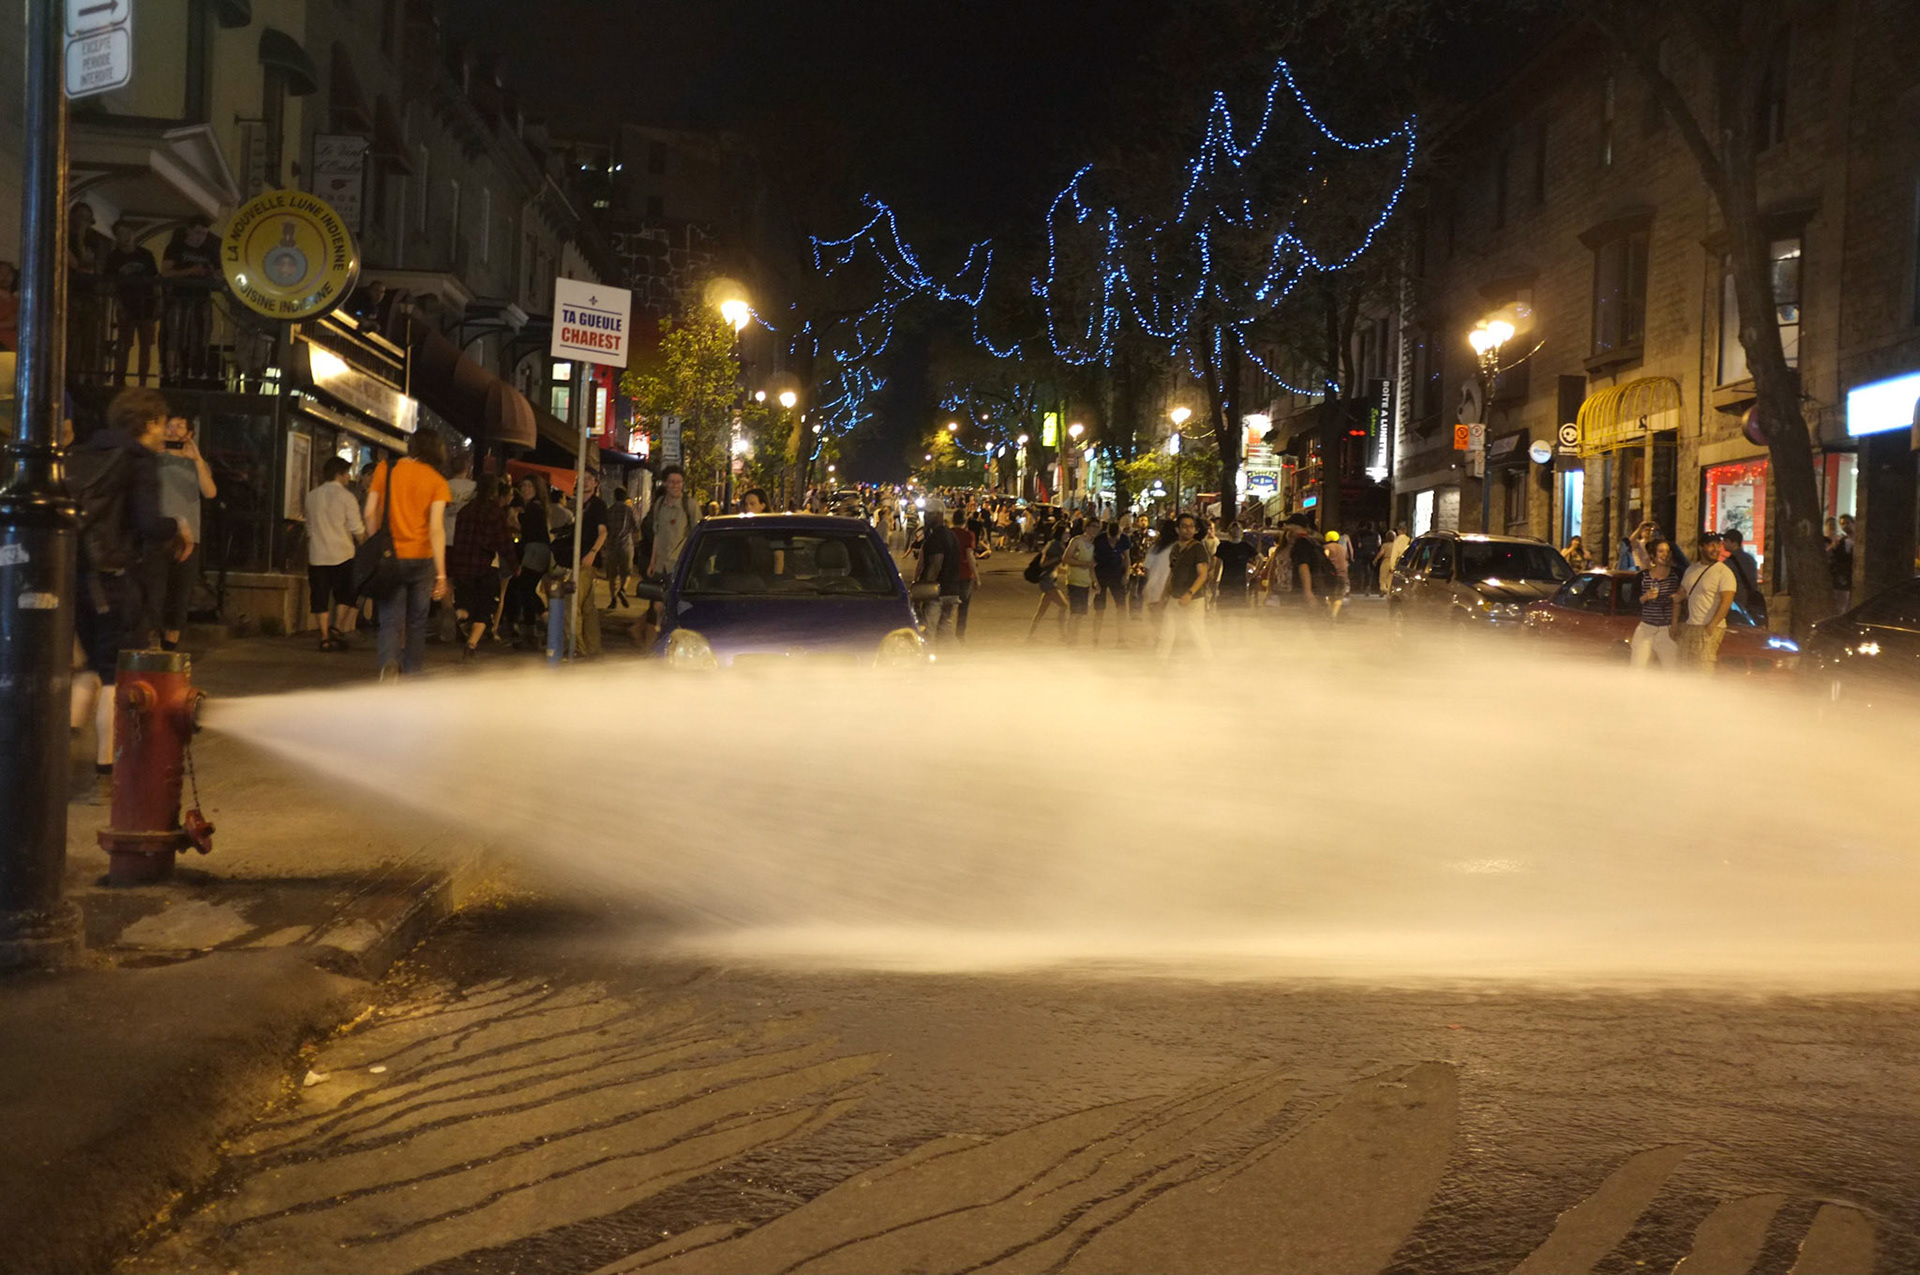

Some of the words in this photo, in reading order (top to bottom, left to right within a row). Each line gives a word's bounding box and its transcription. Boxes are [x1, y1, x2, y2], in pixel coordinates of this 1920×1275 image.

[289, 196, 324, 217] LUNE
[230, 196, 285, 242] NOUVELLE
[227, 245, 239, 263] LA
[320, 213, 346, 272] INDIENNE
[236, 274, 277, 313] UISINE
[562, 309, 575, 324] TA
[579, 312, 622, 332] GUEULE
[561, 327, 621, 350] CHAREST
[668, 417, 676, 429] P
